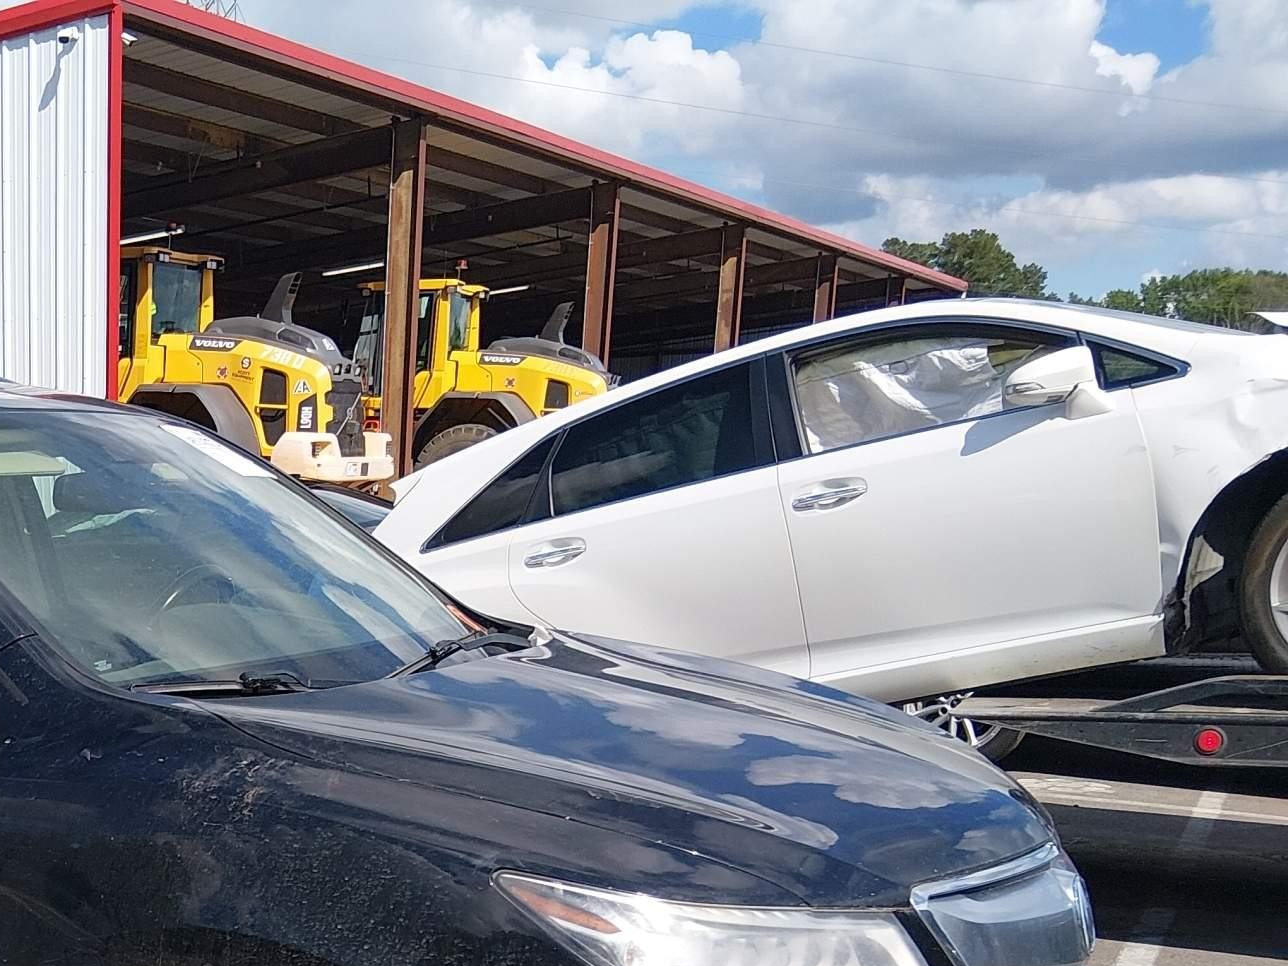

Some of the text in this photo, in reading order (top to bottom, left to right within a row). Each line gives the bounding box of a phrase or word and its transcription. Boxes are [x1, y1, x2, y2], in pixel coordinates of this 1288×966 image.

[194, 339, 236, 349] VOLVO
[483, 355, 521, 364] VOLVO
[300, 406, 313, 429] L90H
